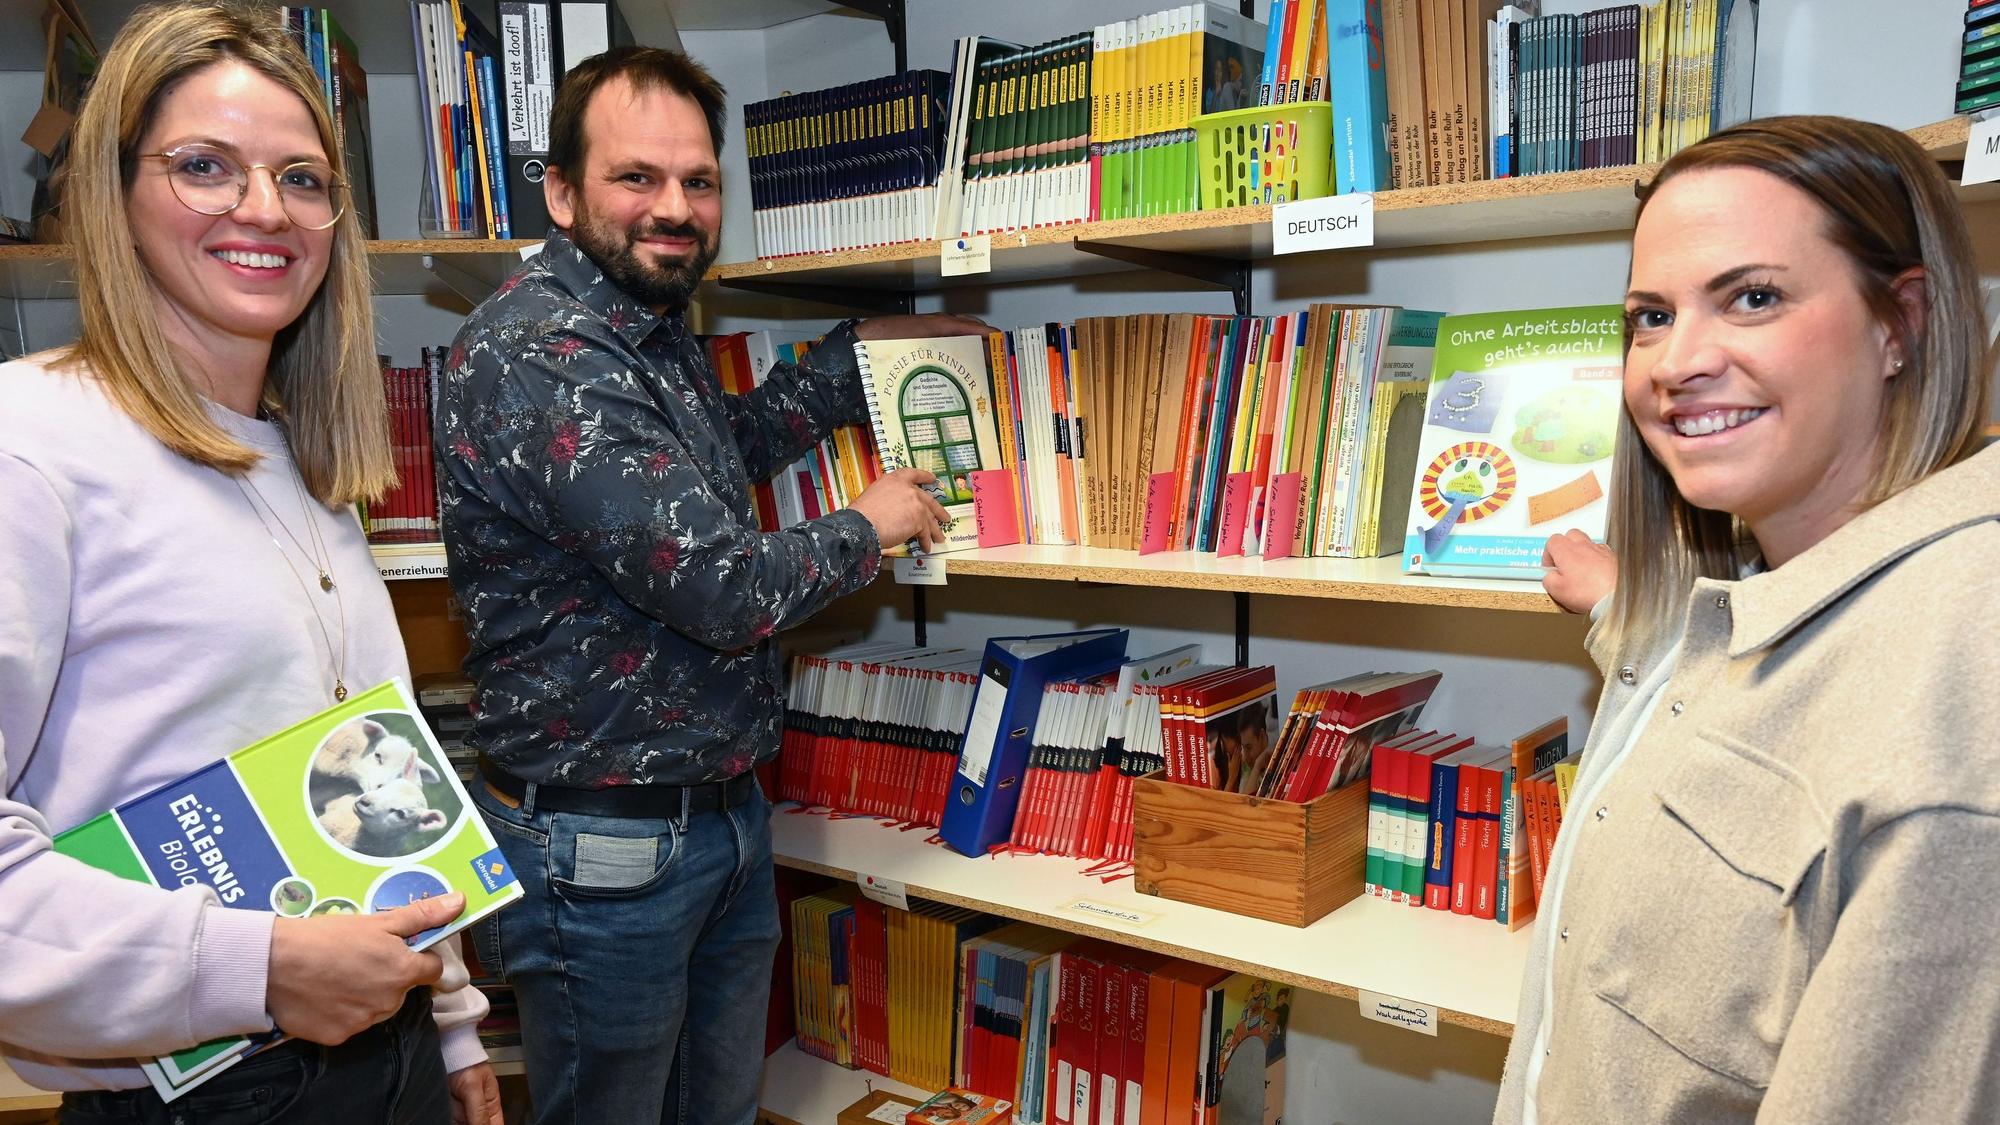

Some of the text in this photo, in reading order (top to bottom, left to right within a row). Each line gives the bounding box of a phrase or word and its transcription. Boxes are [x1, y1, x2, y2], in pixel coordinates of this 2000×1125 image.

[510, 61, 521, 76] ist
[333, 75, 342, 106] Wirtschaft
[1444, 112, 1452, 130] Ruhr
[1454, 104, 1462, 123] Ruhr
[1456, 126, 1464, 142] der
[1432, 149, 1438, 160] an
[1458, 143, 1464, 154] an
[1288, 215, 1358, 240] DEUTSCH
[1451, 327, 1495, 346] Ohne
[1502, 319, 1618, 338] Arbeitsblatt
[1484, 338, 1603, 367] geht's auch!
[884, 347, 977, 396] POESIE FÜR KINDER
[1294, 517, 1304, 540] Verlag
[1454, 544, 1529, 556] Mehr praktische
[1160, 694, 1165, 702] 1
[1187, 696, 1192, 704] 3
[1196, 698, 1200, 706] 4
[1534, 746, 1562, 773] DUDEN
[1502, 799, 1512, 849] Wörterbuch
[168, 791, 246, 906] ERLEBNIS
[475, 858, 498, 890] Schroedel
